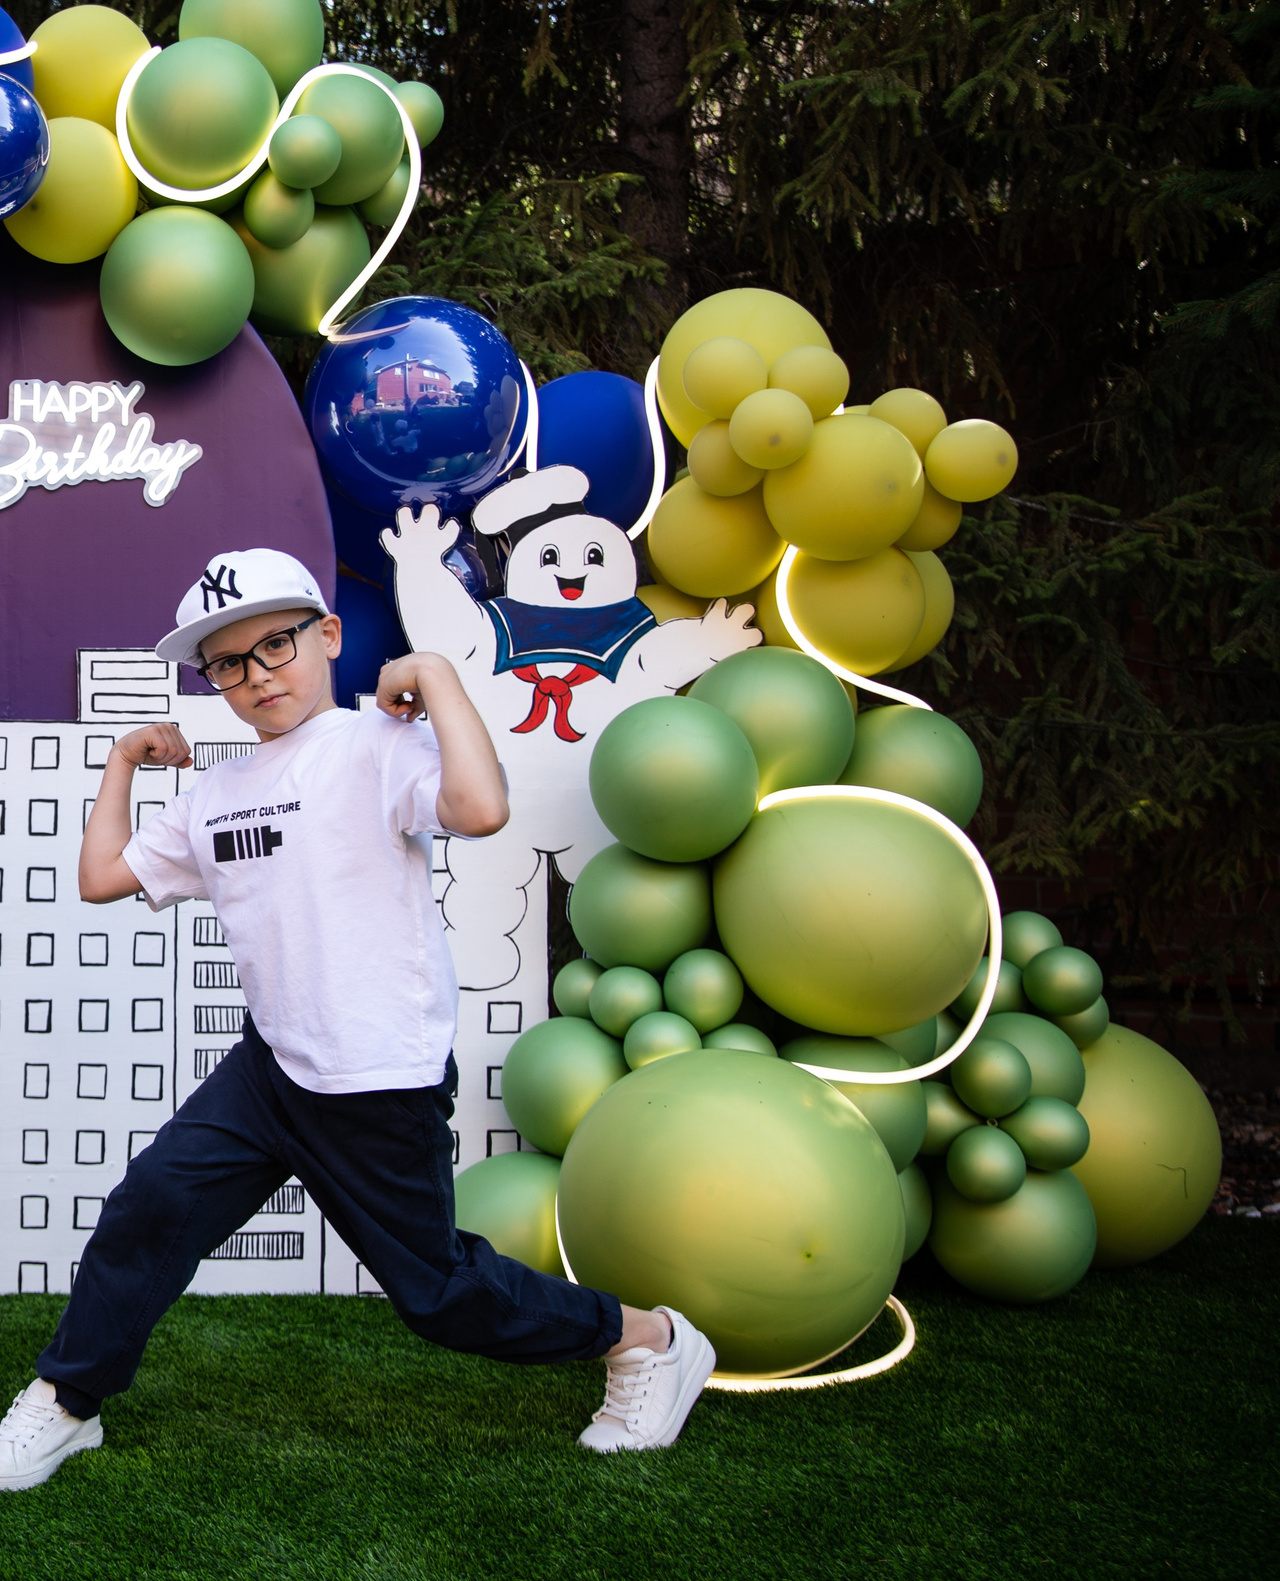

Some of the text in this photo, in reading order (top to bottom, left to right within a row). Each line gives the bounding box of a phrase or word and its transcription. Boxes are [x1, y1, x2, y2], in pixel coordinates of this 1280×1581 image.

[14, 383, 140, 426] HAPPY
[200, 564, 243, 613] NY
[205, 801, 301, 827] NORTH SPORT CULTURE
